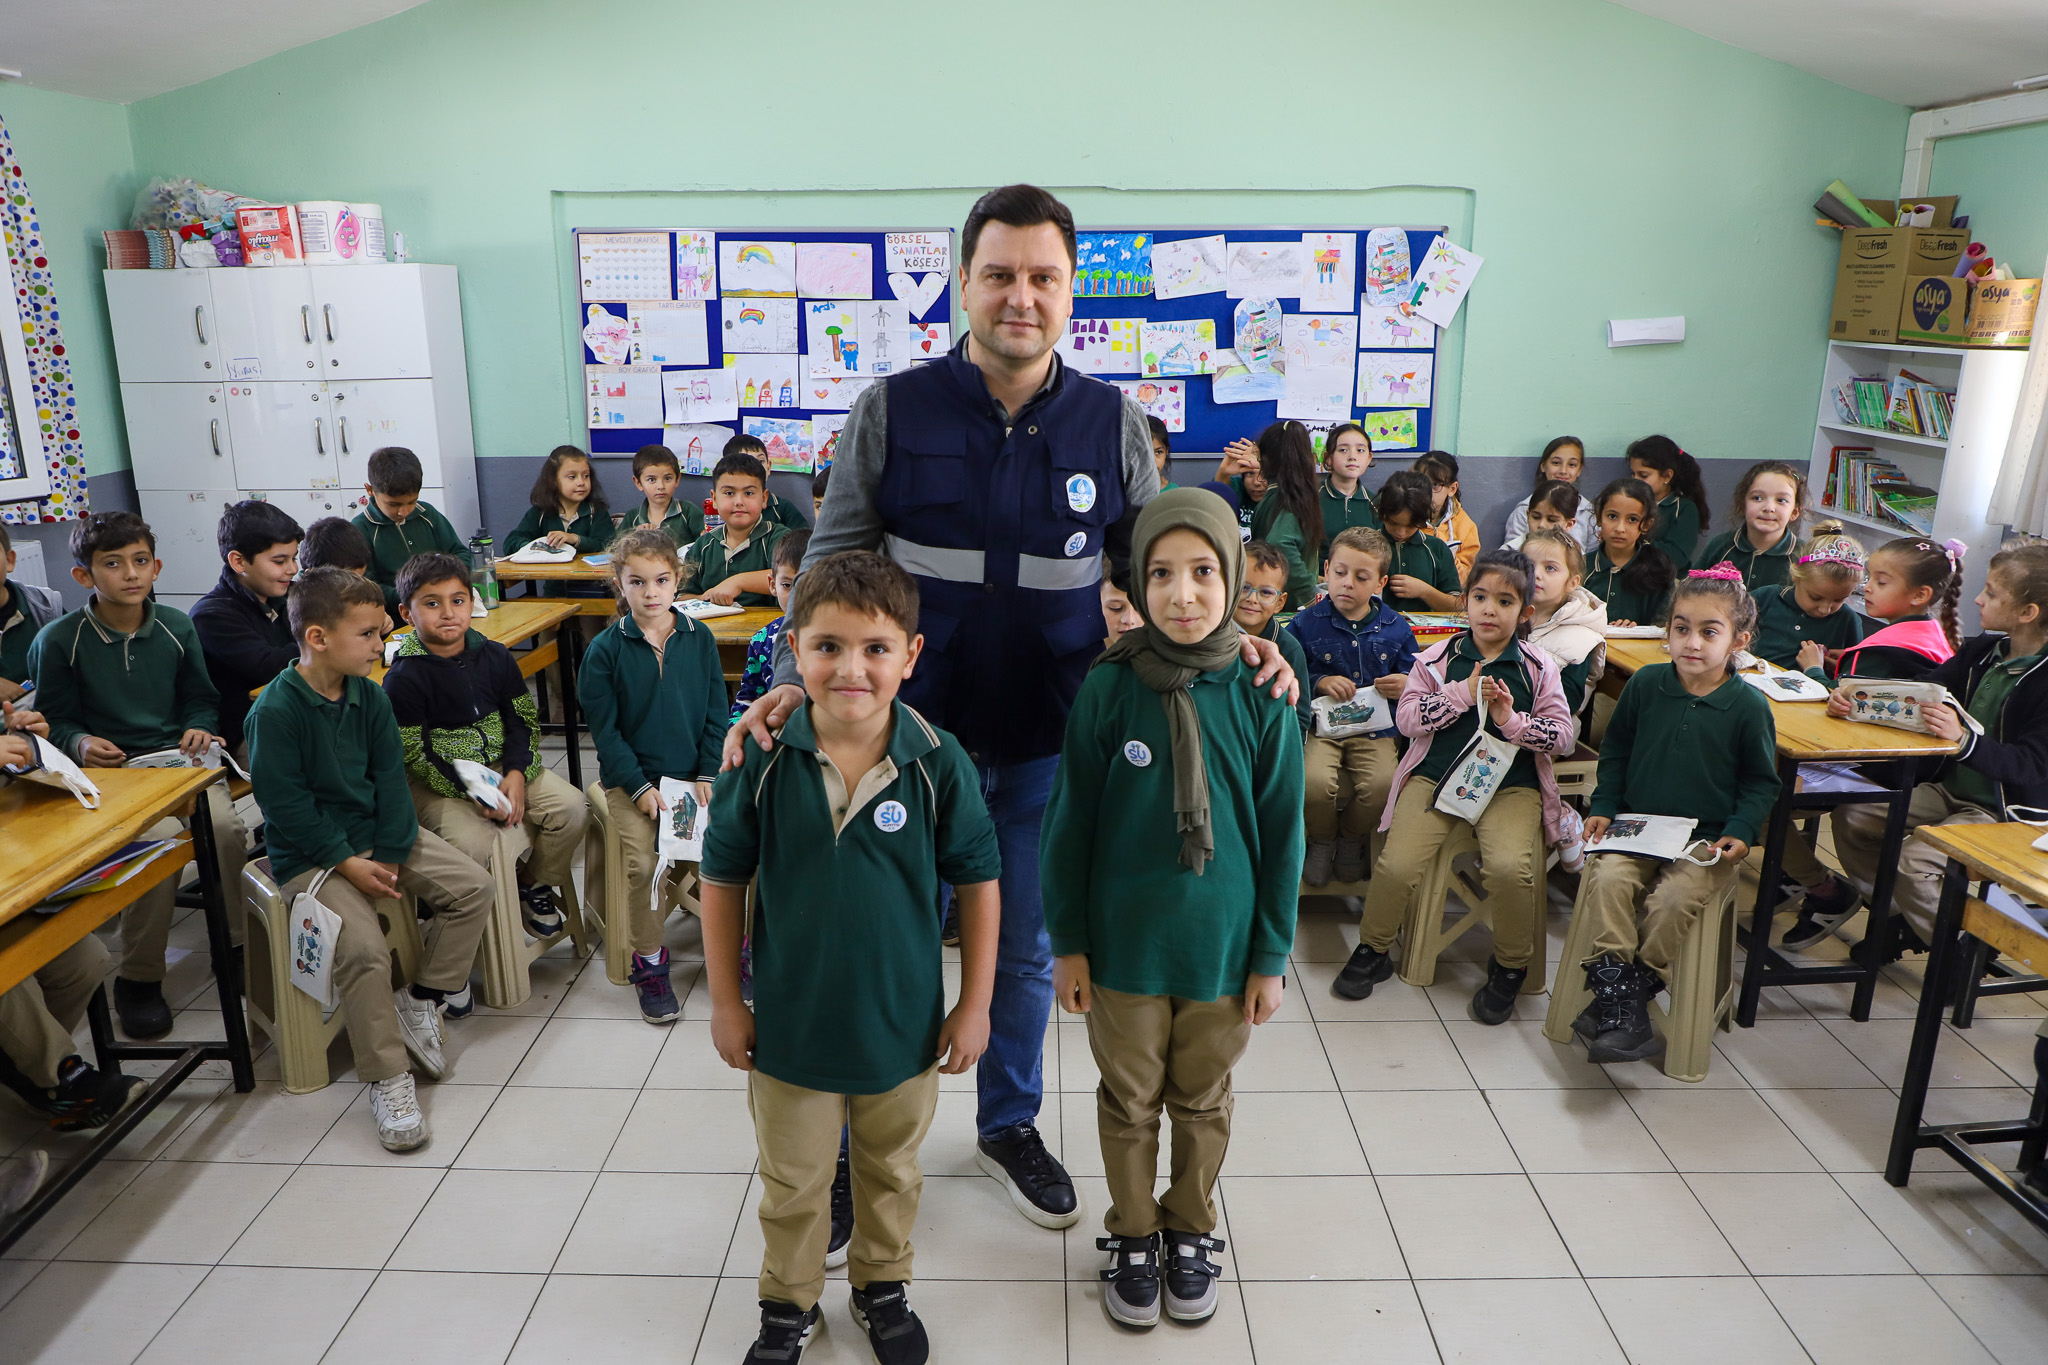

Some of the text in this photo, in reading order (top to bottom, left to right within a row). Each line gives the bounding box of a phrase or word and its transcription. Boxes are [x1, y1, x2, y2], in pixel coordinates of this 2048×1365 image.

[887, 234, 932, 244] GÖRSEL
[892, 246, 948, 256] SANATLAR
[1916, 284, 1945, 315] asya
[1981, 286, 2010, 303] asya
[1128, 748, 1146, 760] SU
[880, 811, 902, 824] SU
[1106, 1240, 1122, 1248] NIKE
[1199, 1238, 1215, 1248] NIKE
